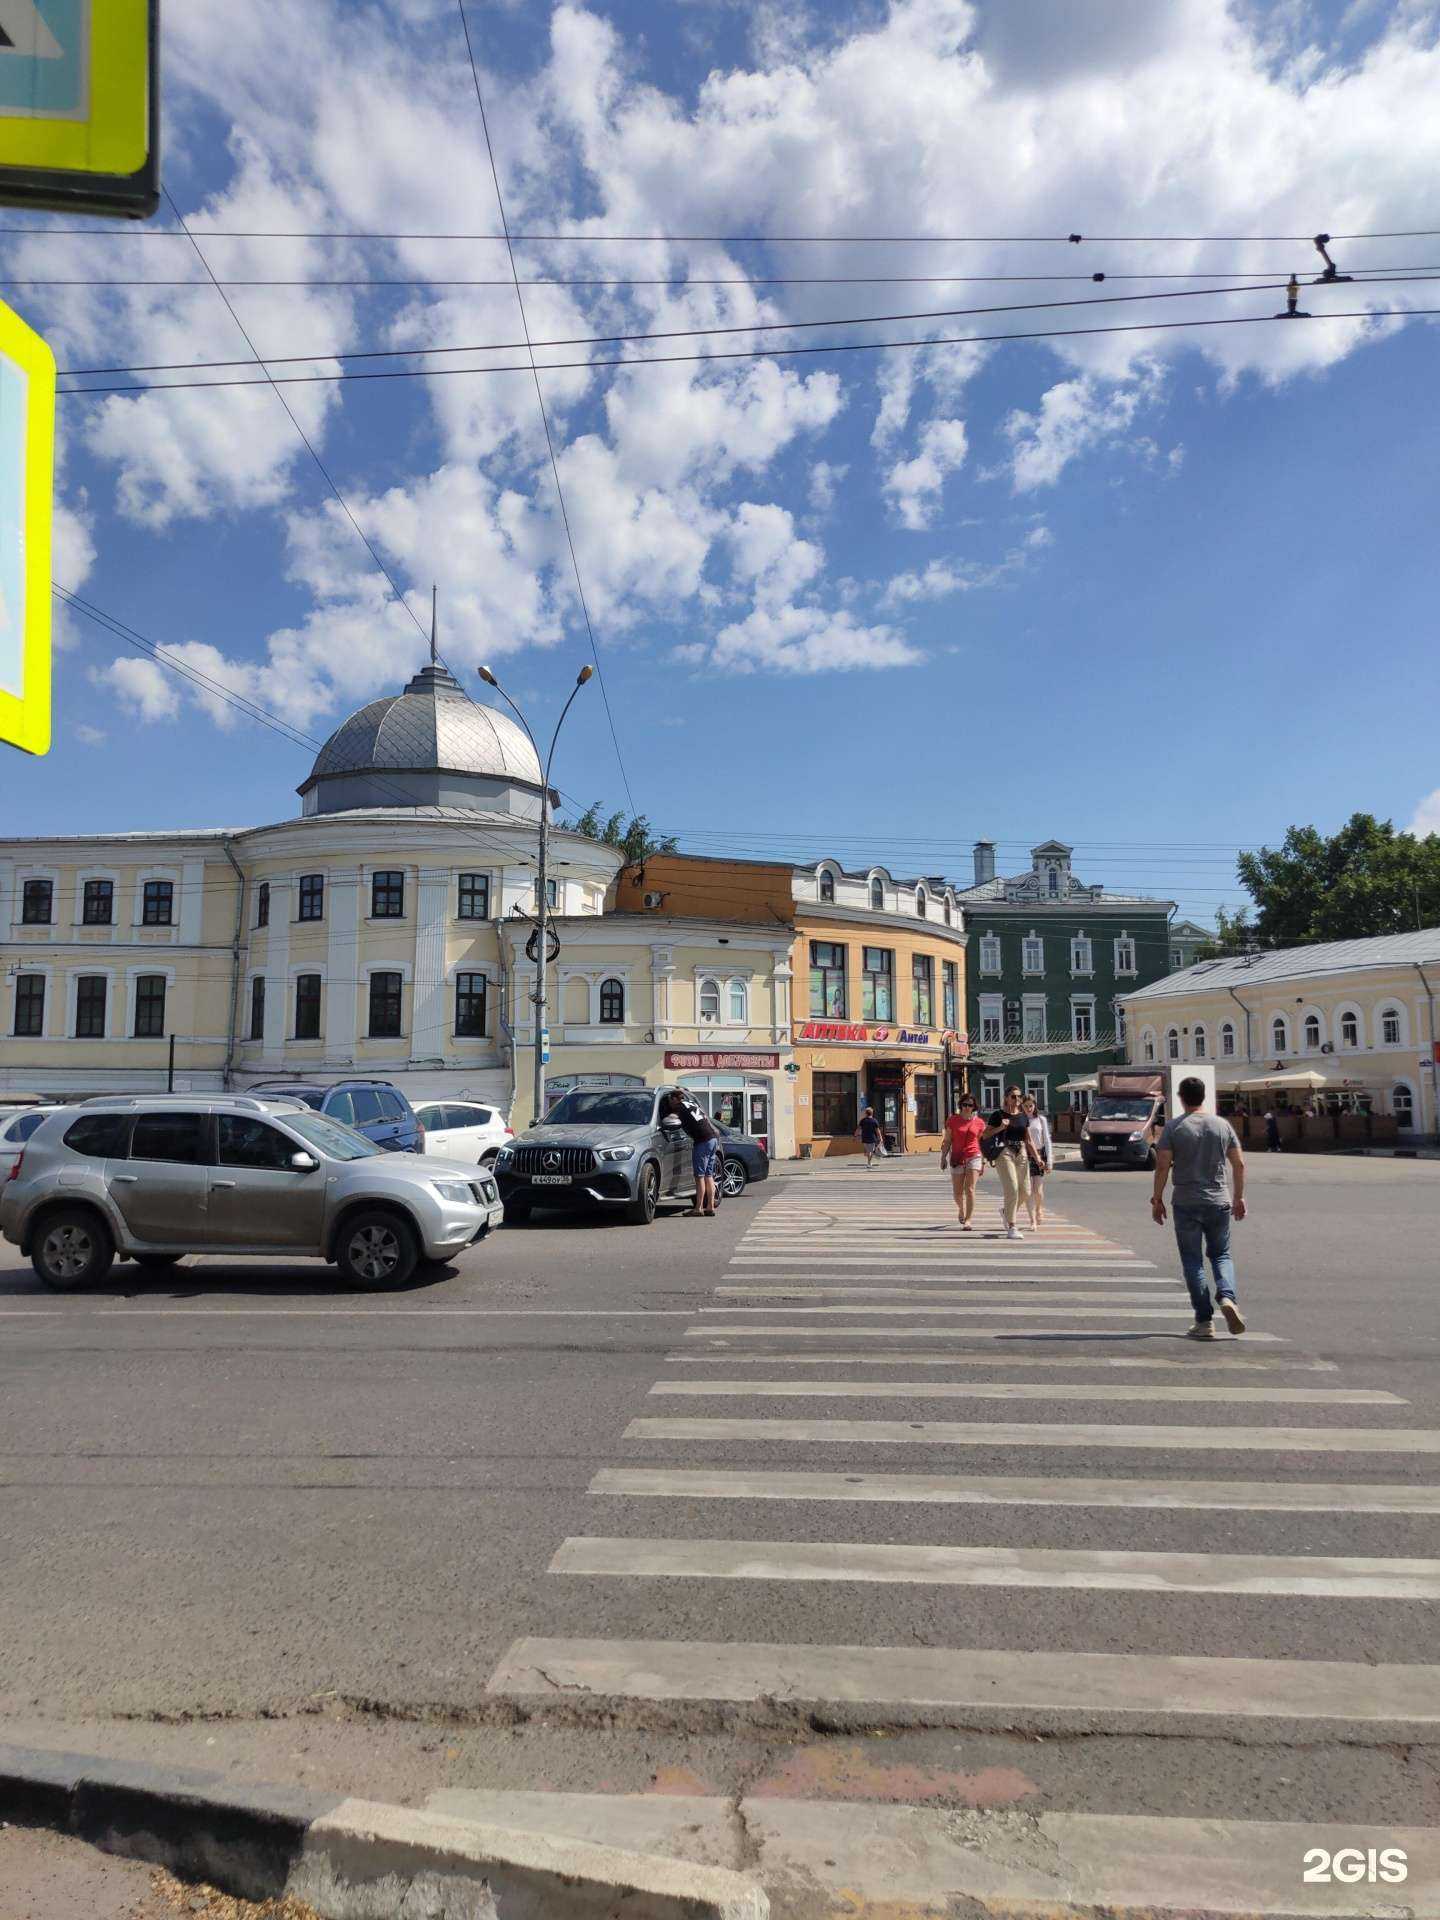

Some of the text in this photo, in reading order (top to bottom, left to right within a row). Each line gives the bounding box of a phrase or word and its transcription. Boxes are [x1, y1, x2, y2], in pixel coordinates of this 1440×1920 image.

[800, 1023, 868, 1041] АПТЕКА
[898, 1030, 929, 1045] Антей
[670, 1053, 700, 1067] ФОТО
[701, 1054, 715, 1067] НА
[716, 1055, 775, 1069] ДОКУМЕНТЫ
